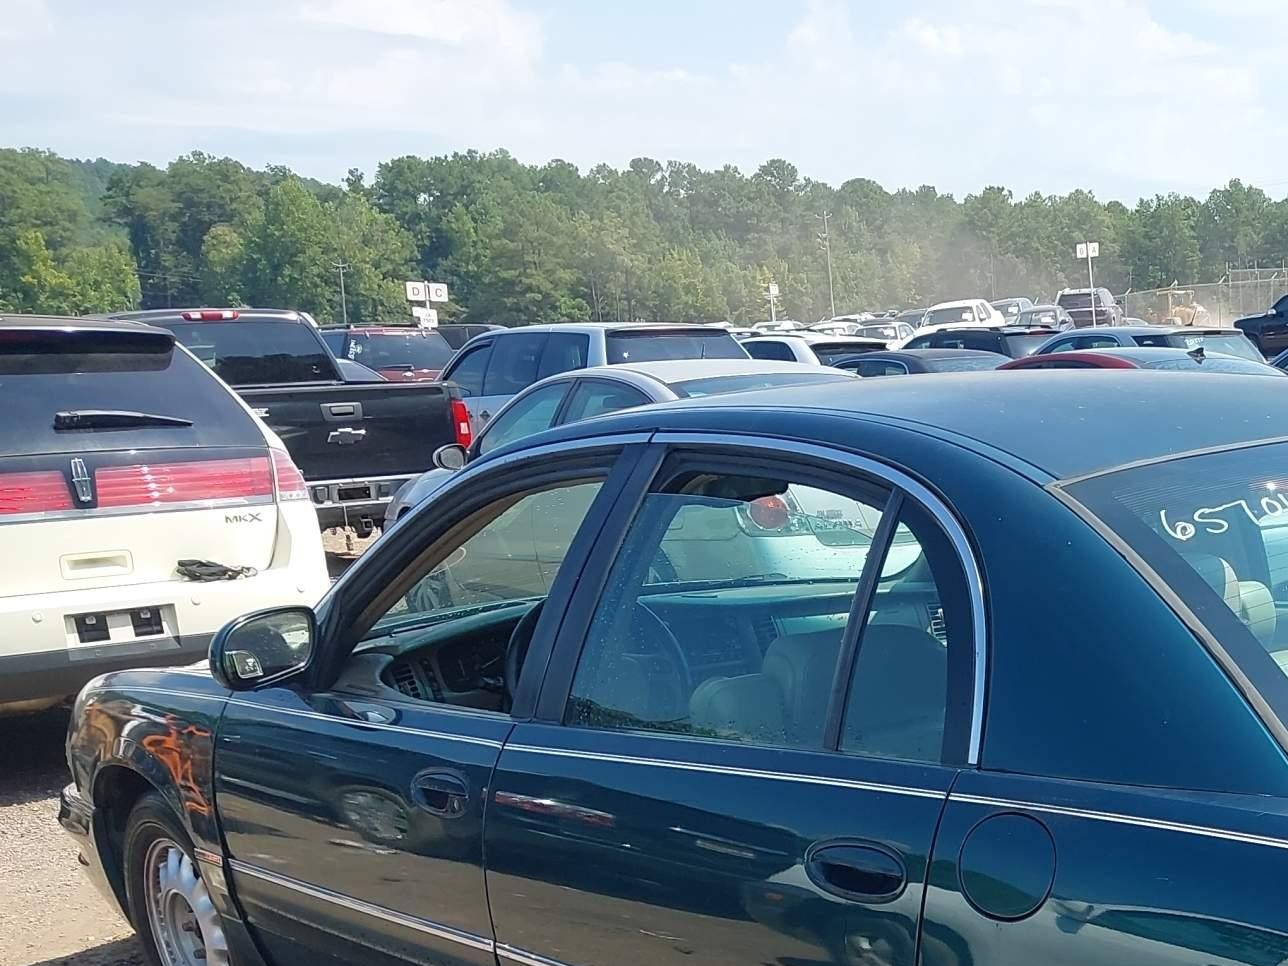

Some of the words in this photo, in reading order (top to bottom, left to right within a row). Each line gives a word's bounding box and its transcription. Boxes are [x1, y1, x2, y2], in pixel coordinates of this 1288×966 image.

[411, 286, 420, 297] D
[435, 287, 443, 298] C
[225, 512, 262, 524] MKX
